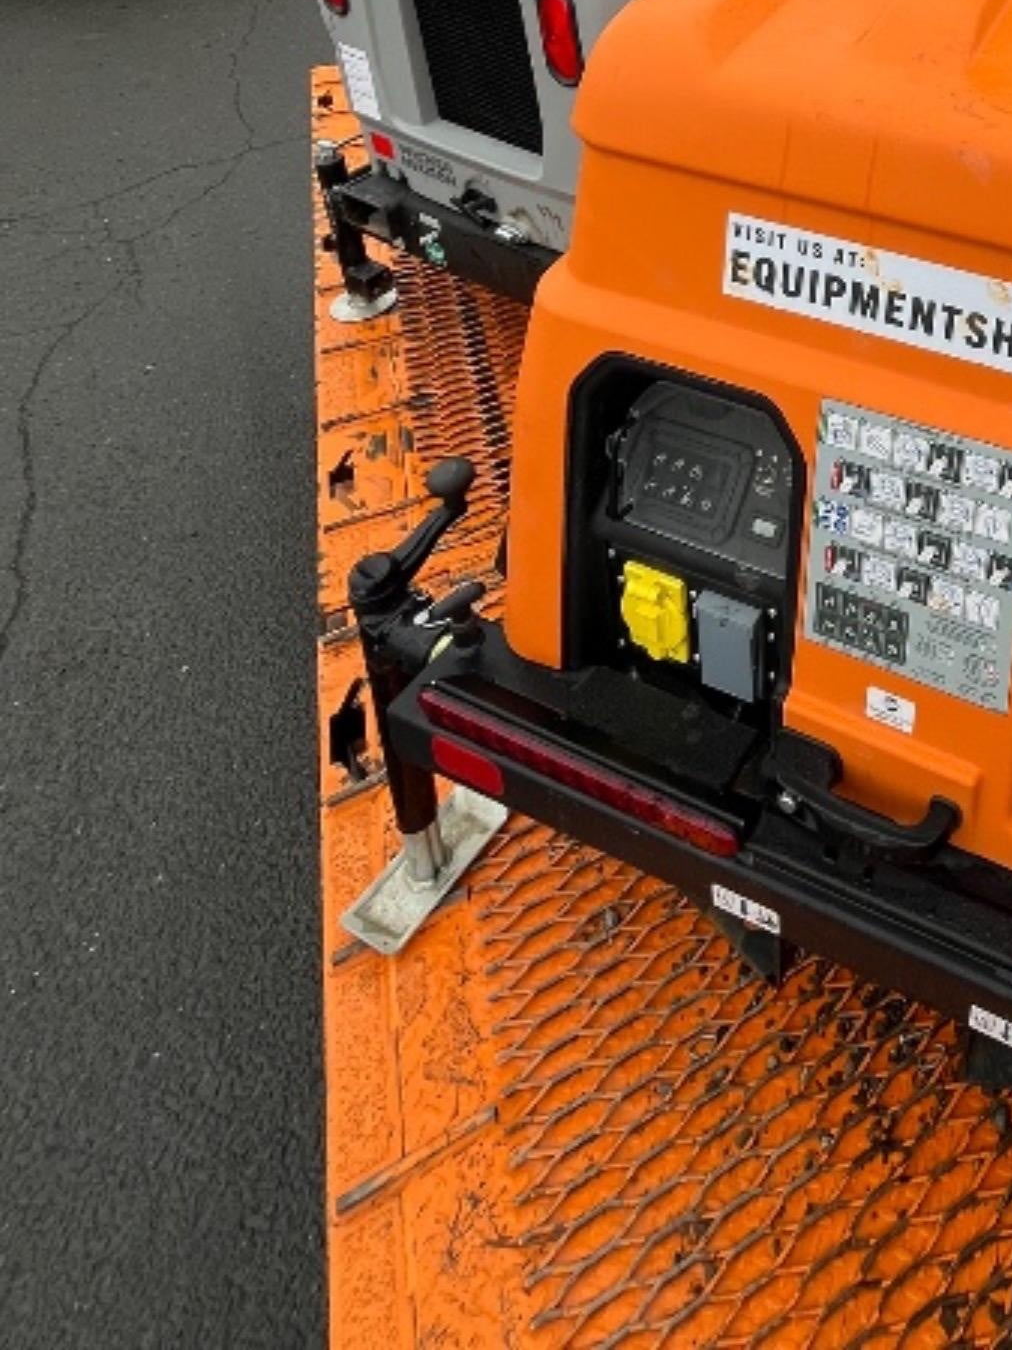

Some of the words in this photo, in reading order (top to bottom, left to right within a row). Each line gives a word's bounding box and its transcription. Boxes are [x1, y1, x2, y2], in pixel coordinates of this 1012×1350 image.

[733, 222, 787, 250] VISIT
[796, 238, 824, 260] US
[832, 247, 866, 269] AT:
